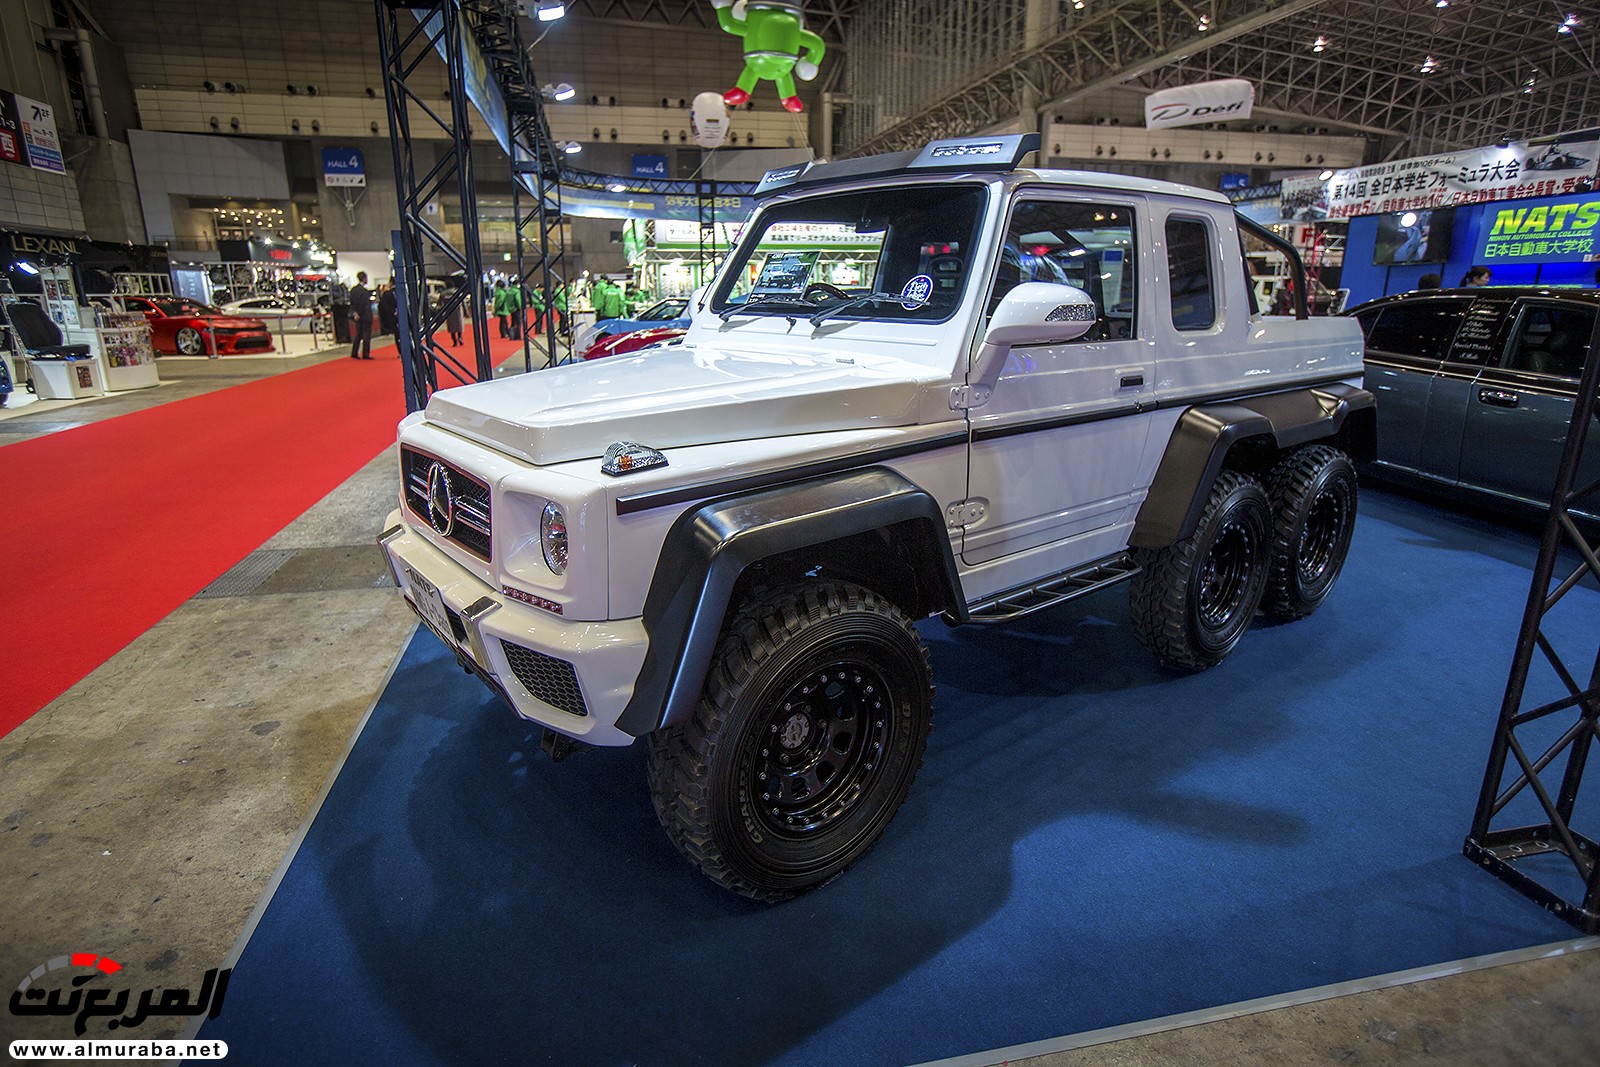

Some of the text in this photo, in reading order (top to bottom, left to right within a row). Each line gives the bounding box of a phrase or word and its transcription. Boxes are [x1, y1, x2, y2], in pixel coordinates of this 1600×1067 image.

[1192, 101, 1244, 116] Defi
[349, 155, 359, 168] 4
[655, 161, 664, 173] 4
[1490, 201, 1600, 235] NATS
[1488, 229, 1594, 242] NIHON AUTOMOBILE COLLEGE
[1484, 238, 1595, 258] 日本自動車大学校
